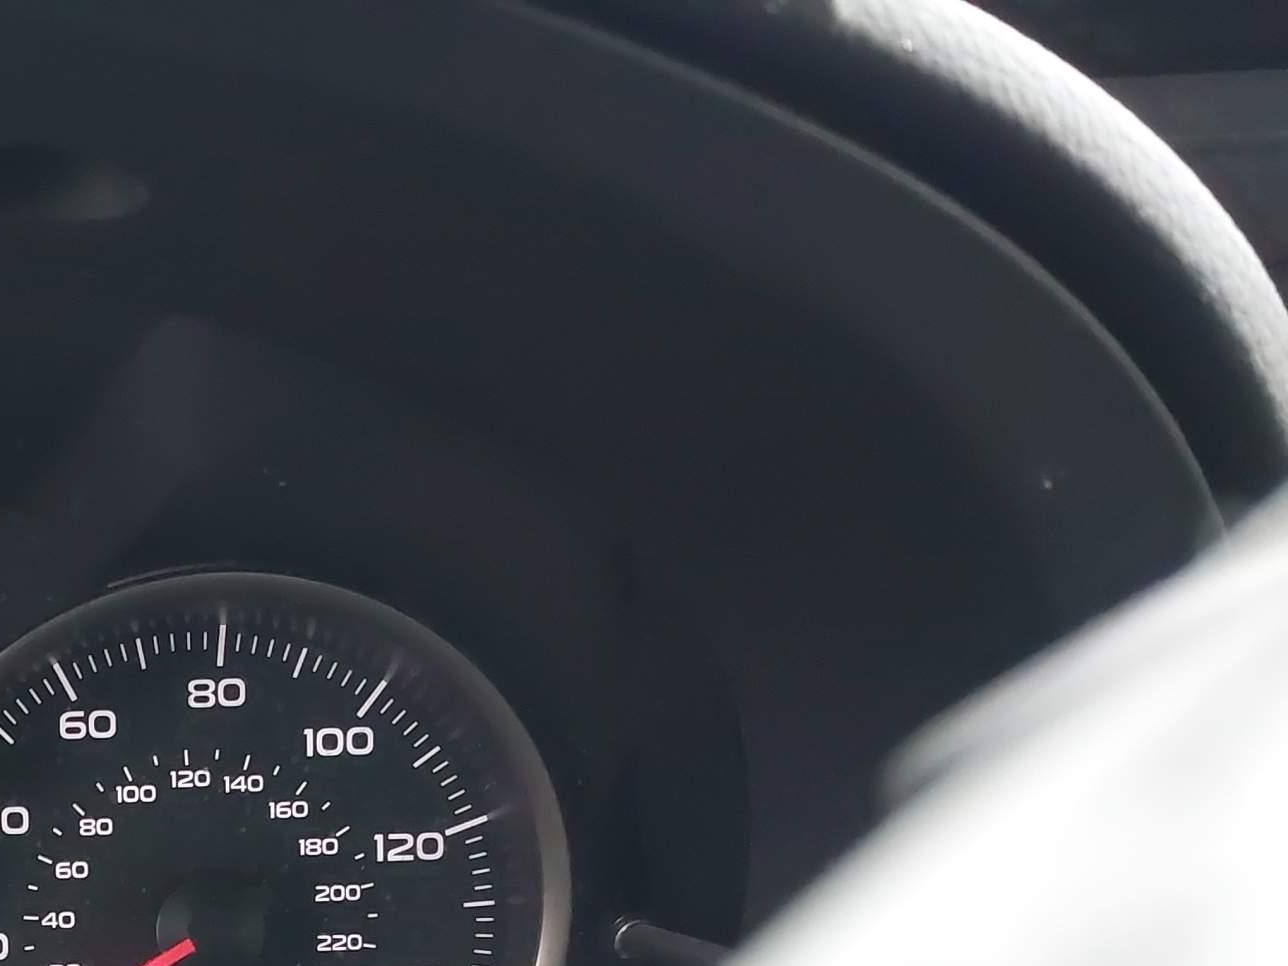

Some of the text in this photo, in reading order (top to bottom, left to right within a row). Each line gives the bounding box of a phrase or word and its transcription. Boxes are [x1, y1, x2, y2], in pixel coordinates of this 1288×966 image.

[187, 677, 246, 708] 80
[59, 709, 117, 740] 60
[303, 726, 374, 757] 100
[169, 767, 211, 789] 120
[223, 774, 264, 794] 140
[115, 782, 157, 804] 100
[268, 800, 309, 819] 160
[79, 817, 113, 836] 80
[298, 837, 339, 856] 180
[373, 832, 443, 862] 120
[55, 860, 89, 879] 60
[314, 886, 359, 902] 200
[41, 911, 76, 929] 40
[316, 934, 361, 952] 220
